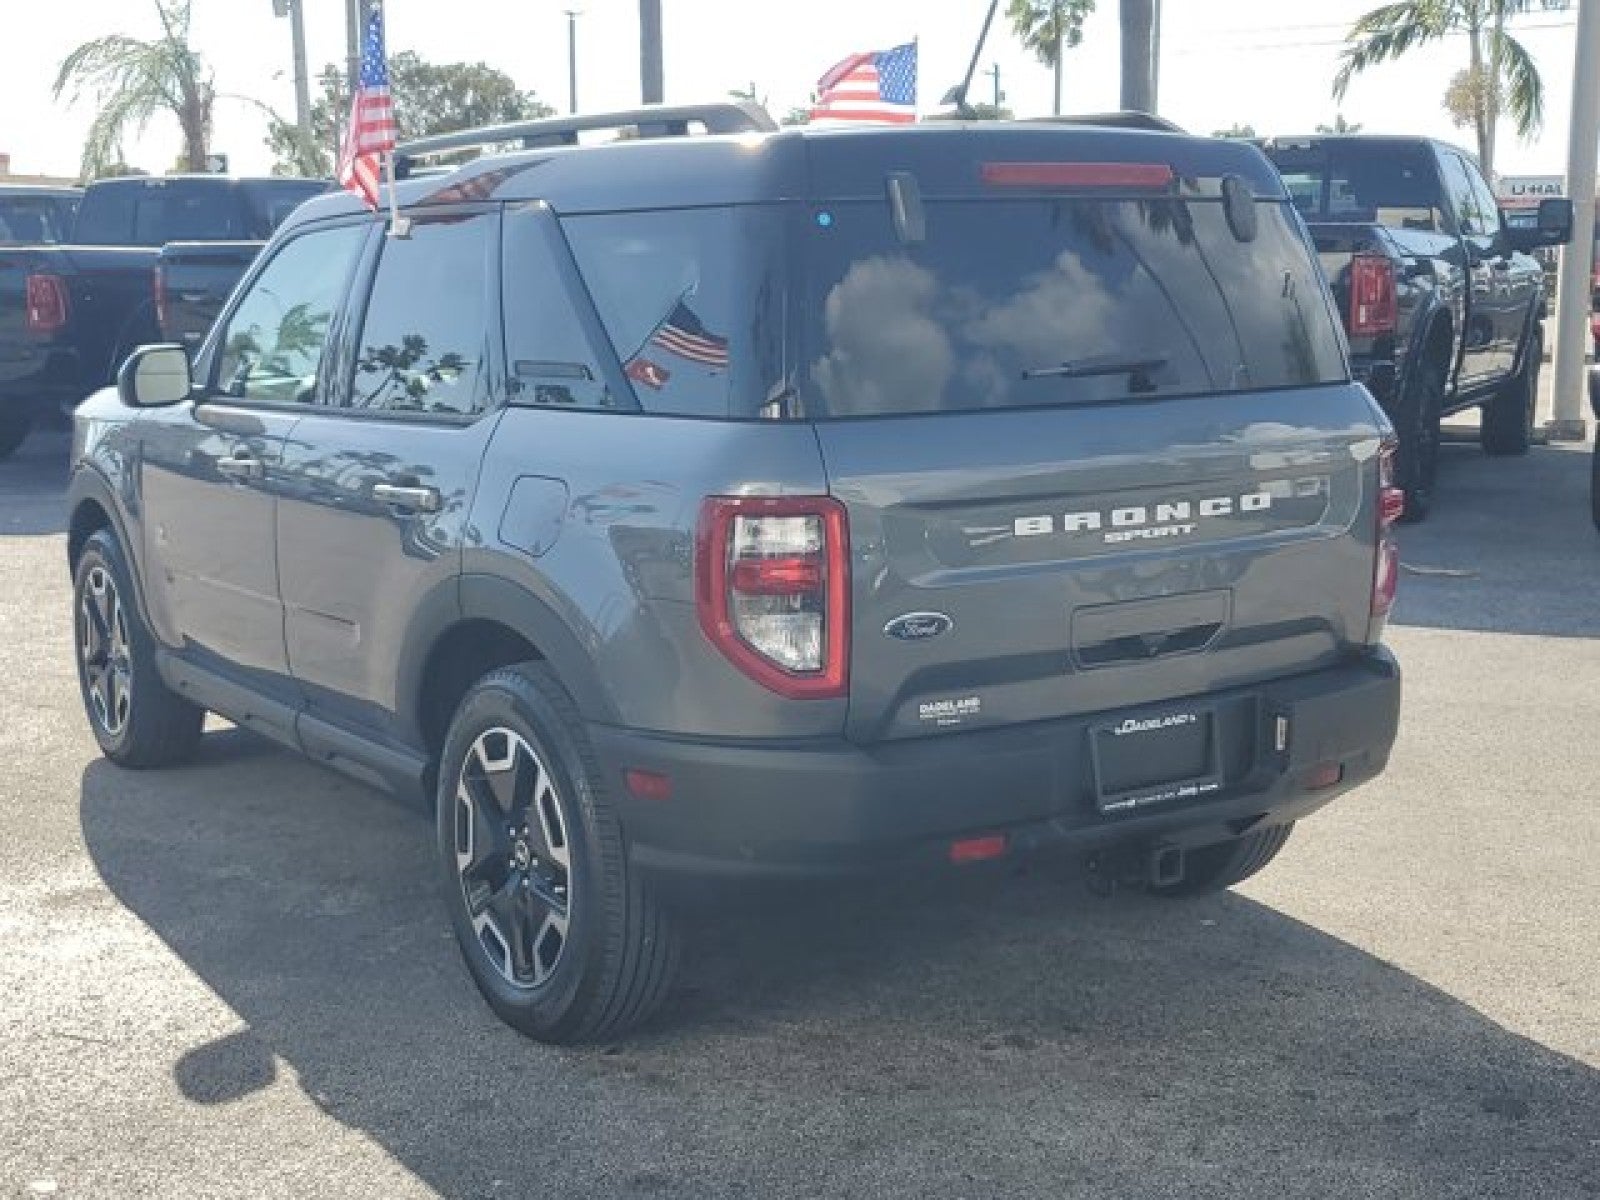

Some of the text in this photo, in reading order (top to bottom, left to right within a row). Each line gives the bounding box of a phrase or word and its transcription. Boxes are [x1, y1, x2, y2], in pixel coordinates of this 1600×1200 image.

[1014, 492, 1274, 536] BRONCO
[1104, 523, 1194, 544] SPORT
[901, 616, 940, 637] Ford
